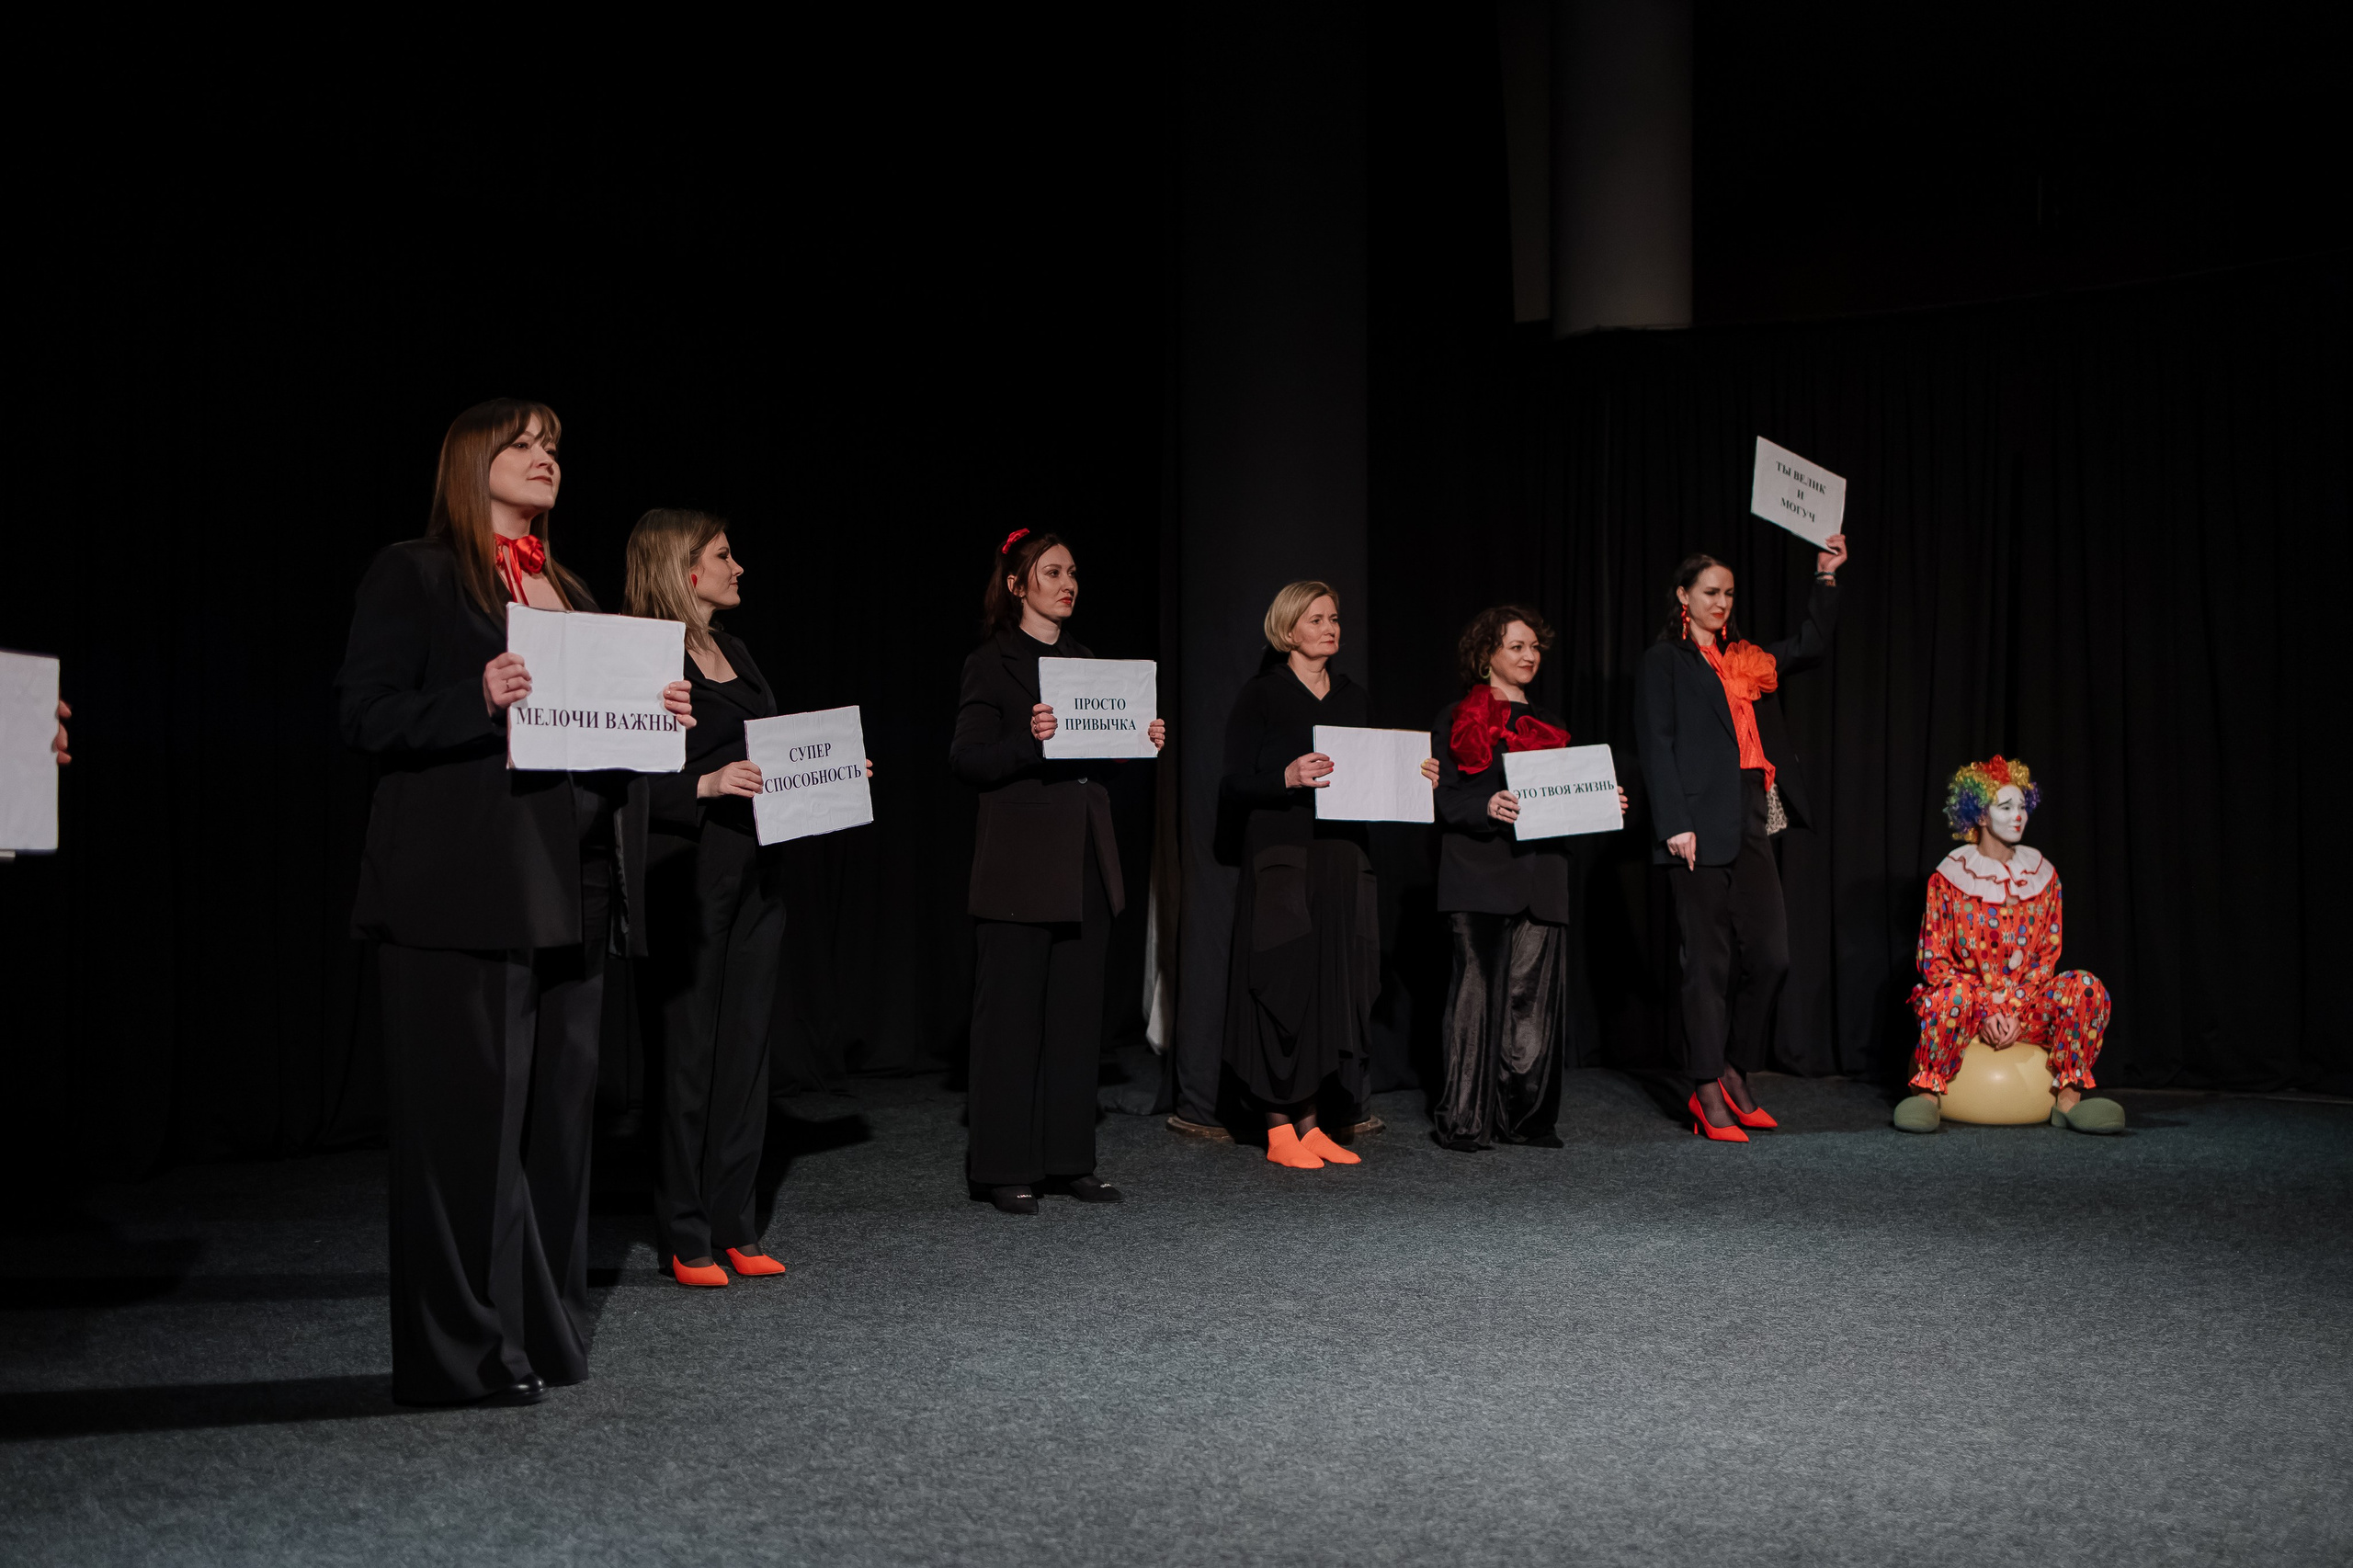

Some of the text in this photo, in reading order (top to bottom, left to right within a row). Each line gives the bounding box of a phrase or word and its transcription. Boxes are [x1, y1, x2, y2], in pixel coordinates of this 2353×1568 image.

[1776, 460, 1826, 494] ТЫ ВЕЛИК
[1797, 489, 1803, 500] И
[1781, 497, 1815, 522] МОГУЧ
[1074, 698, 1126, 710] ПРОСТО
[517, 707, 678, 732] МЕЛОЧИ ВАЖНЫ
[1065, 718, 1136, 731] ПРИВЫЧКА
[789, 743, 831, 763] СУПЕР
[765, 764, 861, 793] СПОСОБНОСТЬ
[1513, 780, 1615, 800] ЭТО ТВОЯ ЖИЗНЬ
